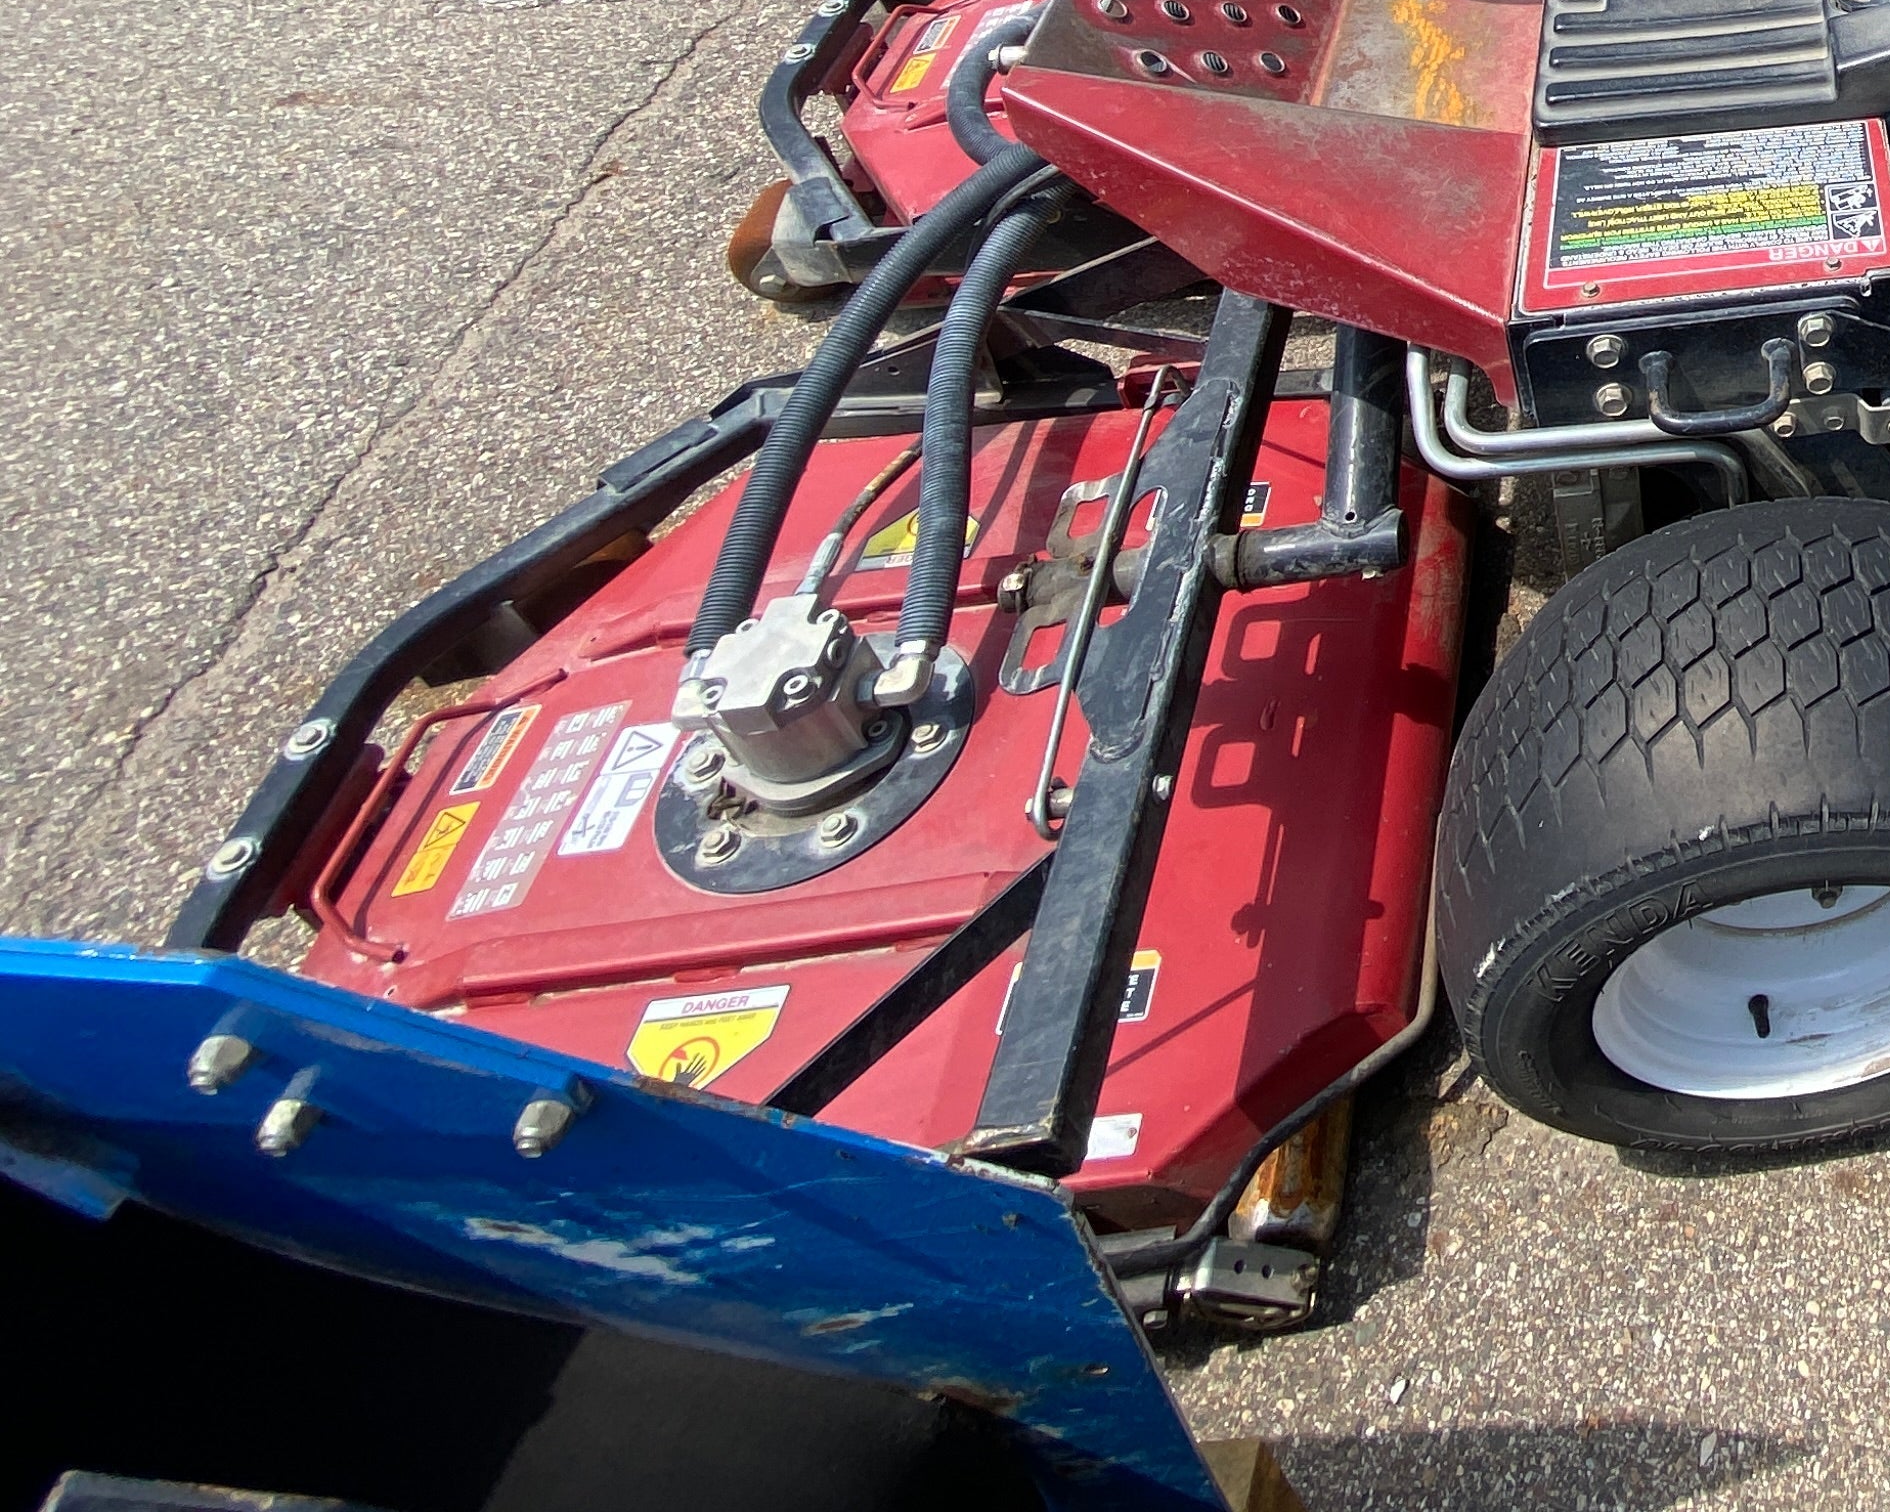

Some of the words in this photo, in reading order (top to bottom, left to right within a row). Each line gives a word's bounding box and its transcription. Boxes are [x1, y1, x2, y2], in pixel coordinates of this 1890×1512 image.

[1768, 240, 1858, 261] DANGER
[1534, 880, 1713, 1004] KENDA
[681, 995, 750, 1015] DANGER
